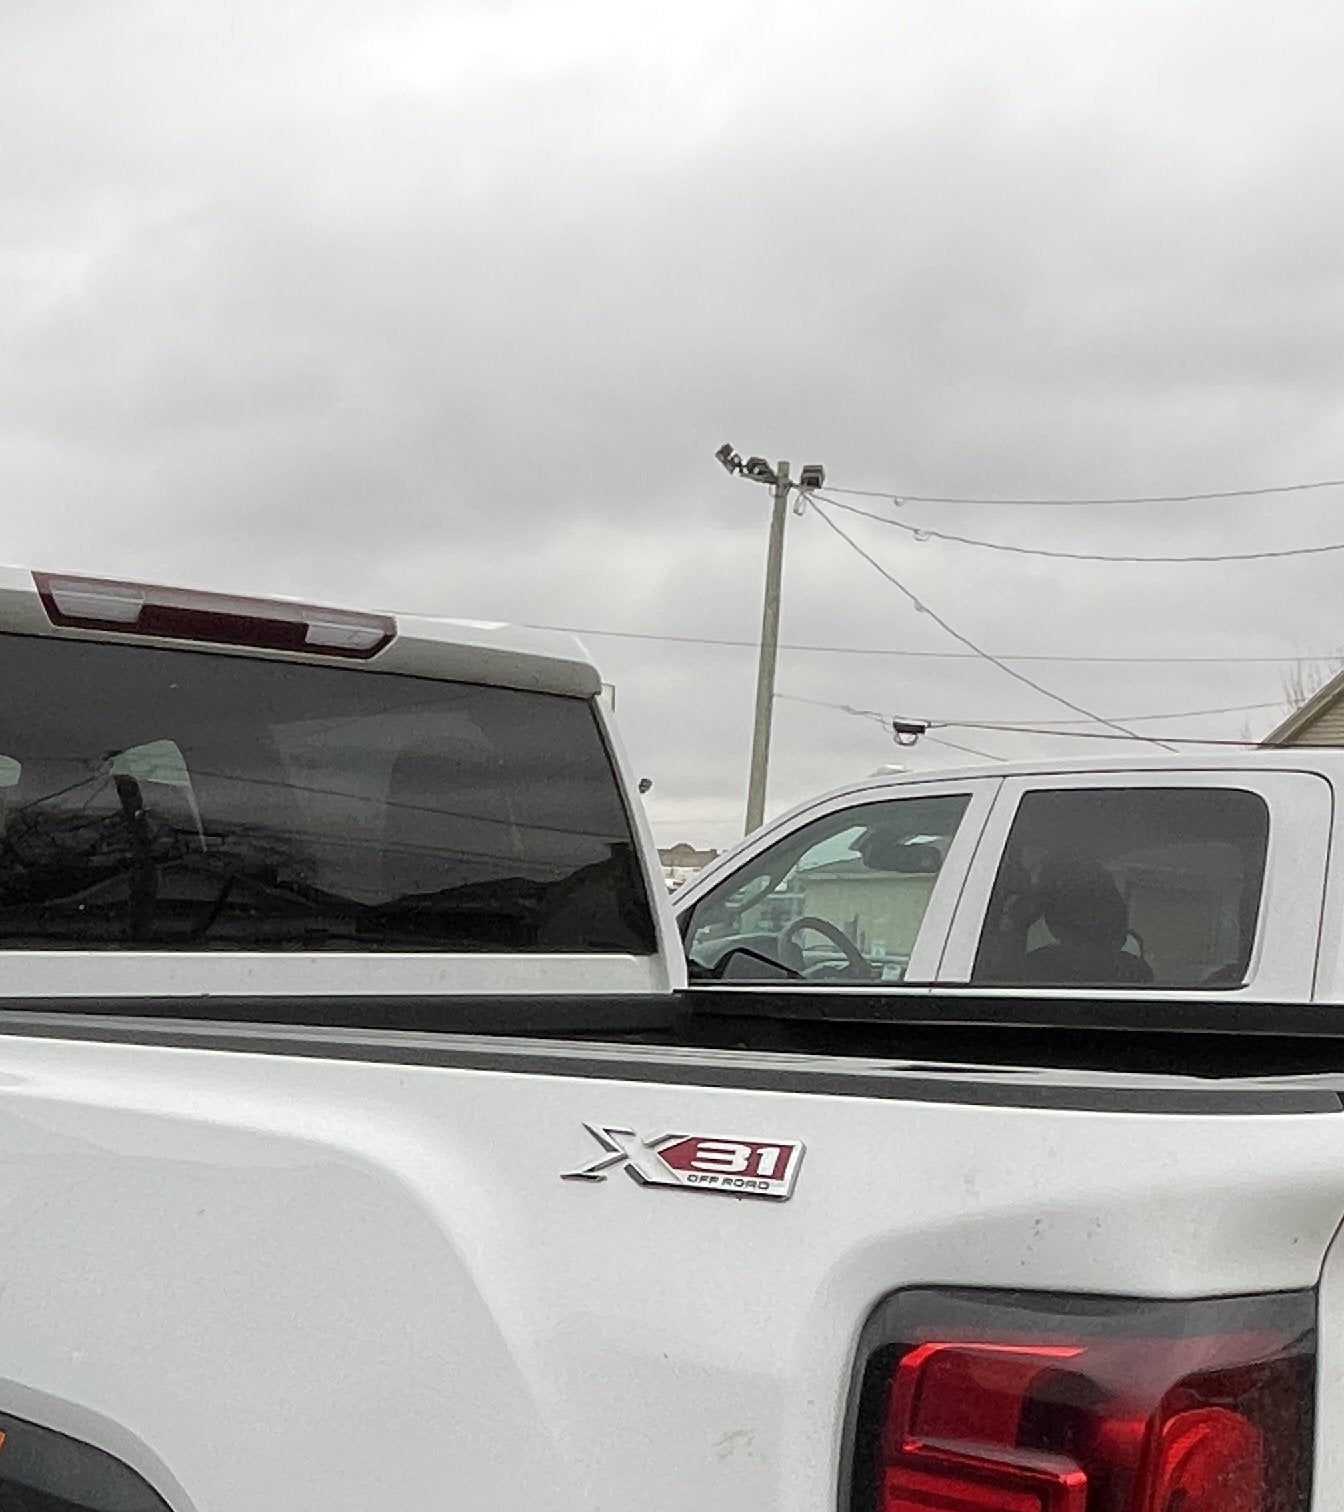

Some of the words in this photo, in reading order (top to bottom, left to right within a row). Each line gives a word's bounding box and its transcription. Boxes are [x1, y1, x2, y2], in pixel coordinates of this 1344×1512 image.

[560, 1122, 790, 1192] X31
[687, 1174, 719, 1186] OFF
[722, 1176, 770, 1191] ROAD
